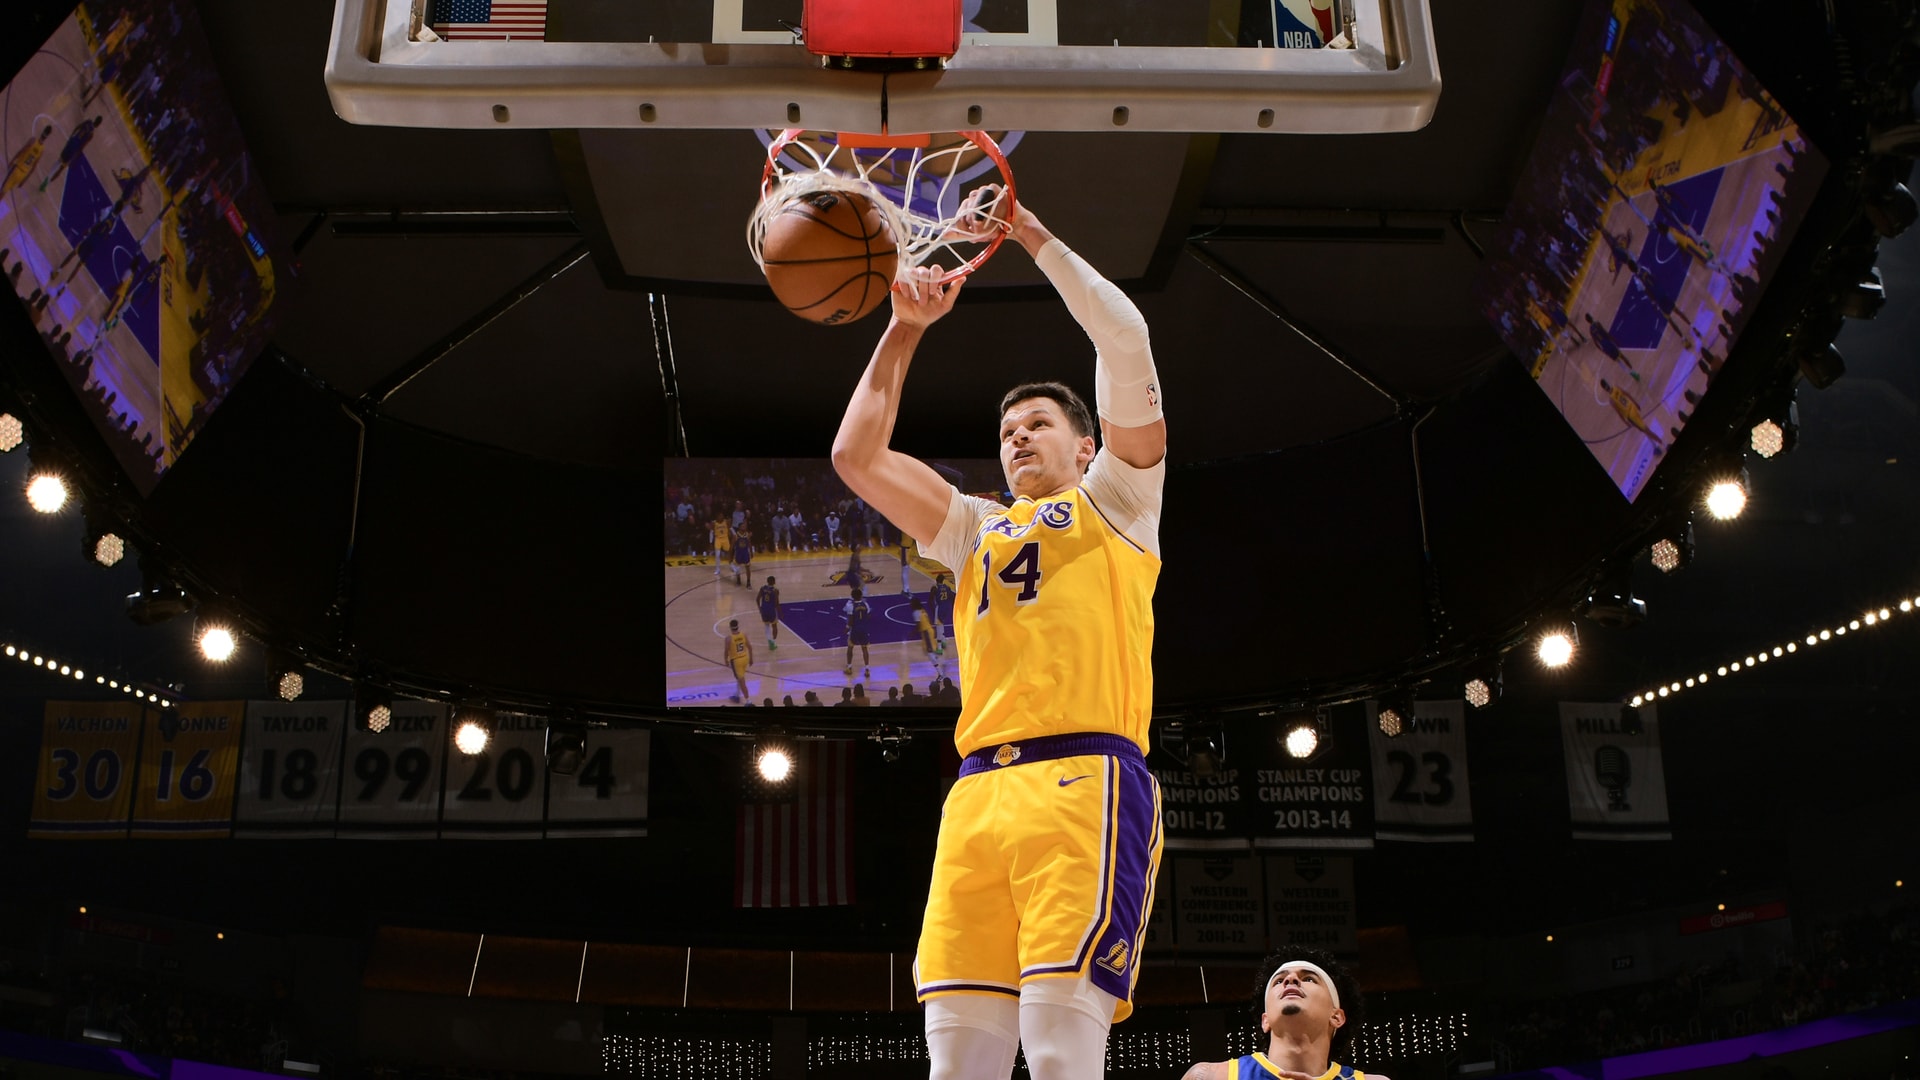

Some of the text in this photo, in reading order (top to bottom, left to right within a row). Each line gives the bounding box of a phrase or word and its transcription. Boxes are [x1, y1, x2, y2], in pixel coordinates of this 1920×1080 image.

[1283, 31, 1313, 48] NBA
[978, 542, 1041, 616] 14
[57, 717, 129, 732] VACHON
[164, 716, 229, 731] ONNE
[263, 716, 328, 732] TAYLOR
[1576, 718, 1644, 734] MILL
[47, 748, 122, 802] 30
[156, 749, 215, 802] 16
[259, 748, 317, 800] 18
[354, 747, 431, 802] 99
[457, 747, 535, 801] 20
[1257, 769, 1362, 784] STANLEY CUP
[1386, 750, 1454, 805] 23
[1162, 785, 1241, 804] AMPIONS
[1258, 786, 1365, 802] CHAMPIONS
[1165, 809, 1227, 831] 011-12
[1273, 809, 1353, 830] 2013-14
[1191, 885, 1249, 898] WESTERN
[1281, 887, 1339, 899] WESTERN
[1181, 899, 1259, 912] CONFERENCE
[1273, 901, 1350, 913] CONFERENCE
[1186, 913, 1255, 925] CHAMPIONS
[1277, 914, 1348, 926] CHAMPIONS
[1196, 930, 1246, 944] 2011-12
[1287, 931, 1340, 945] 2013-14
